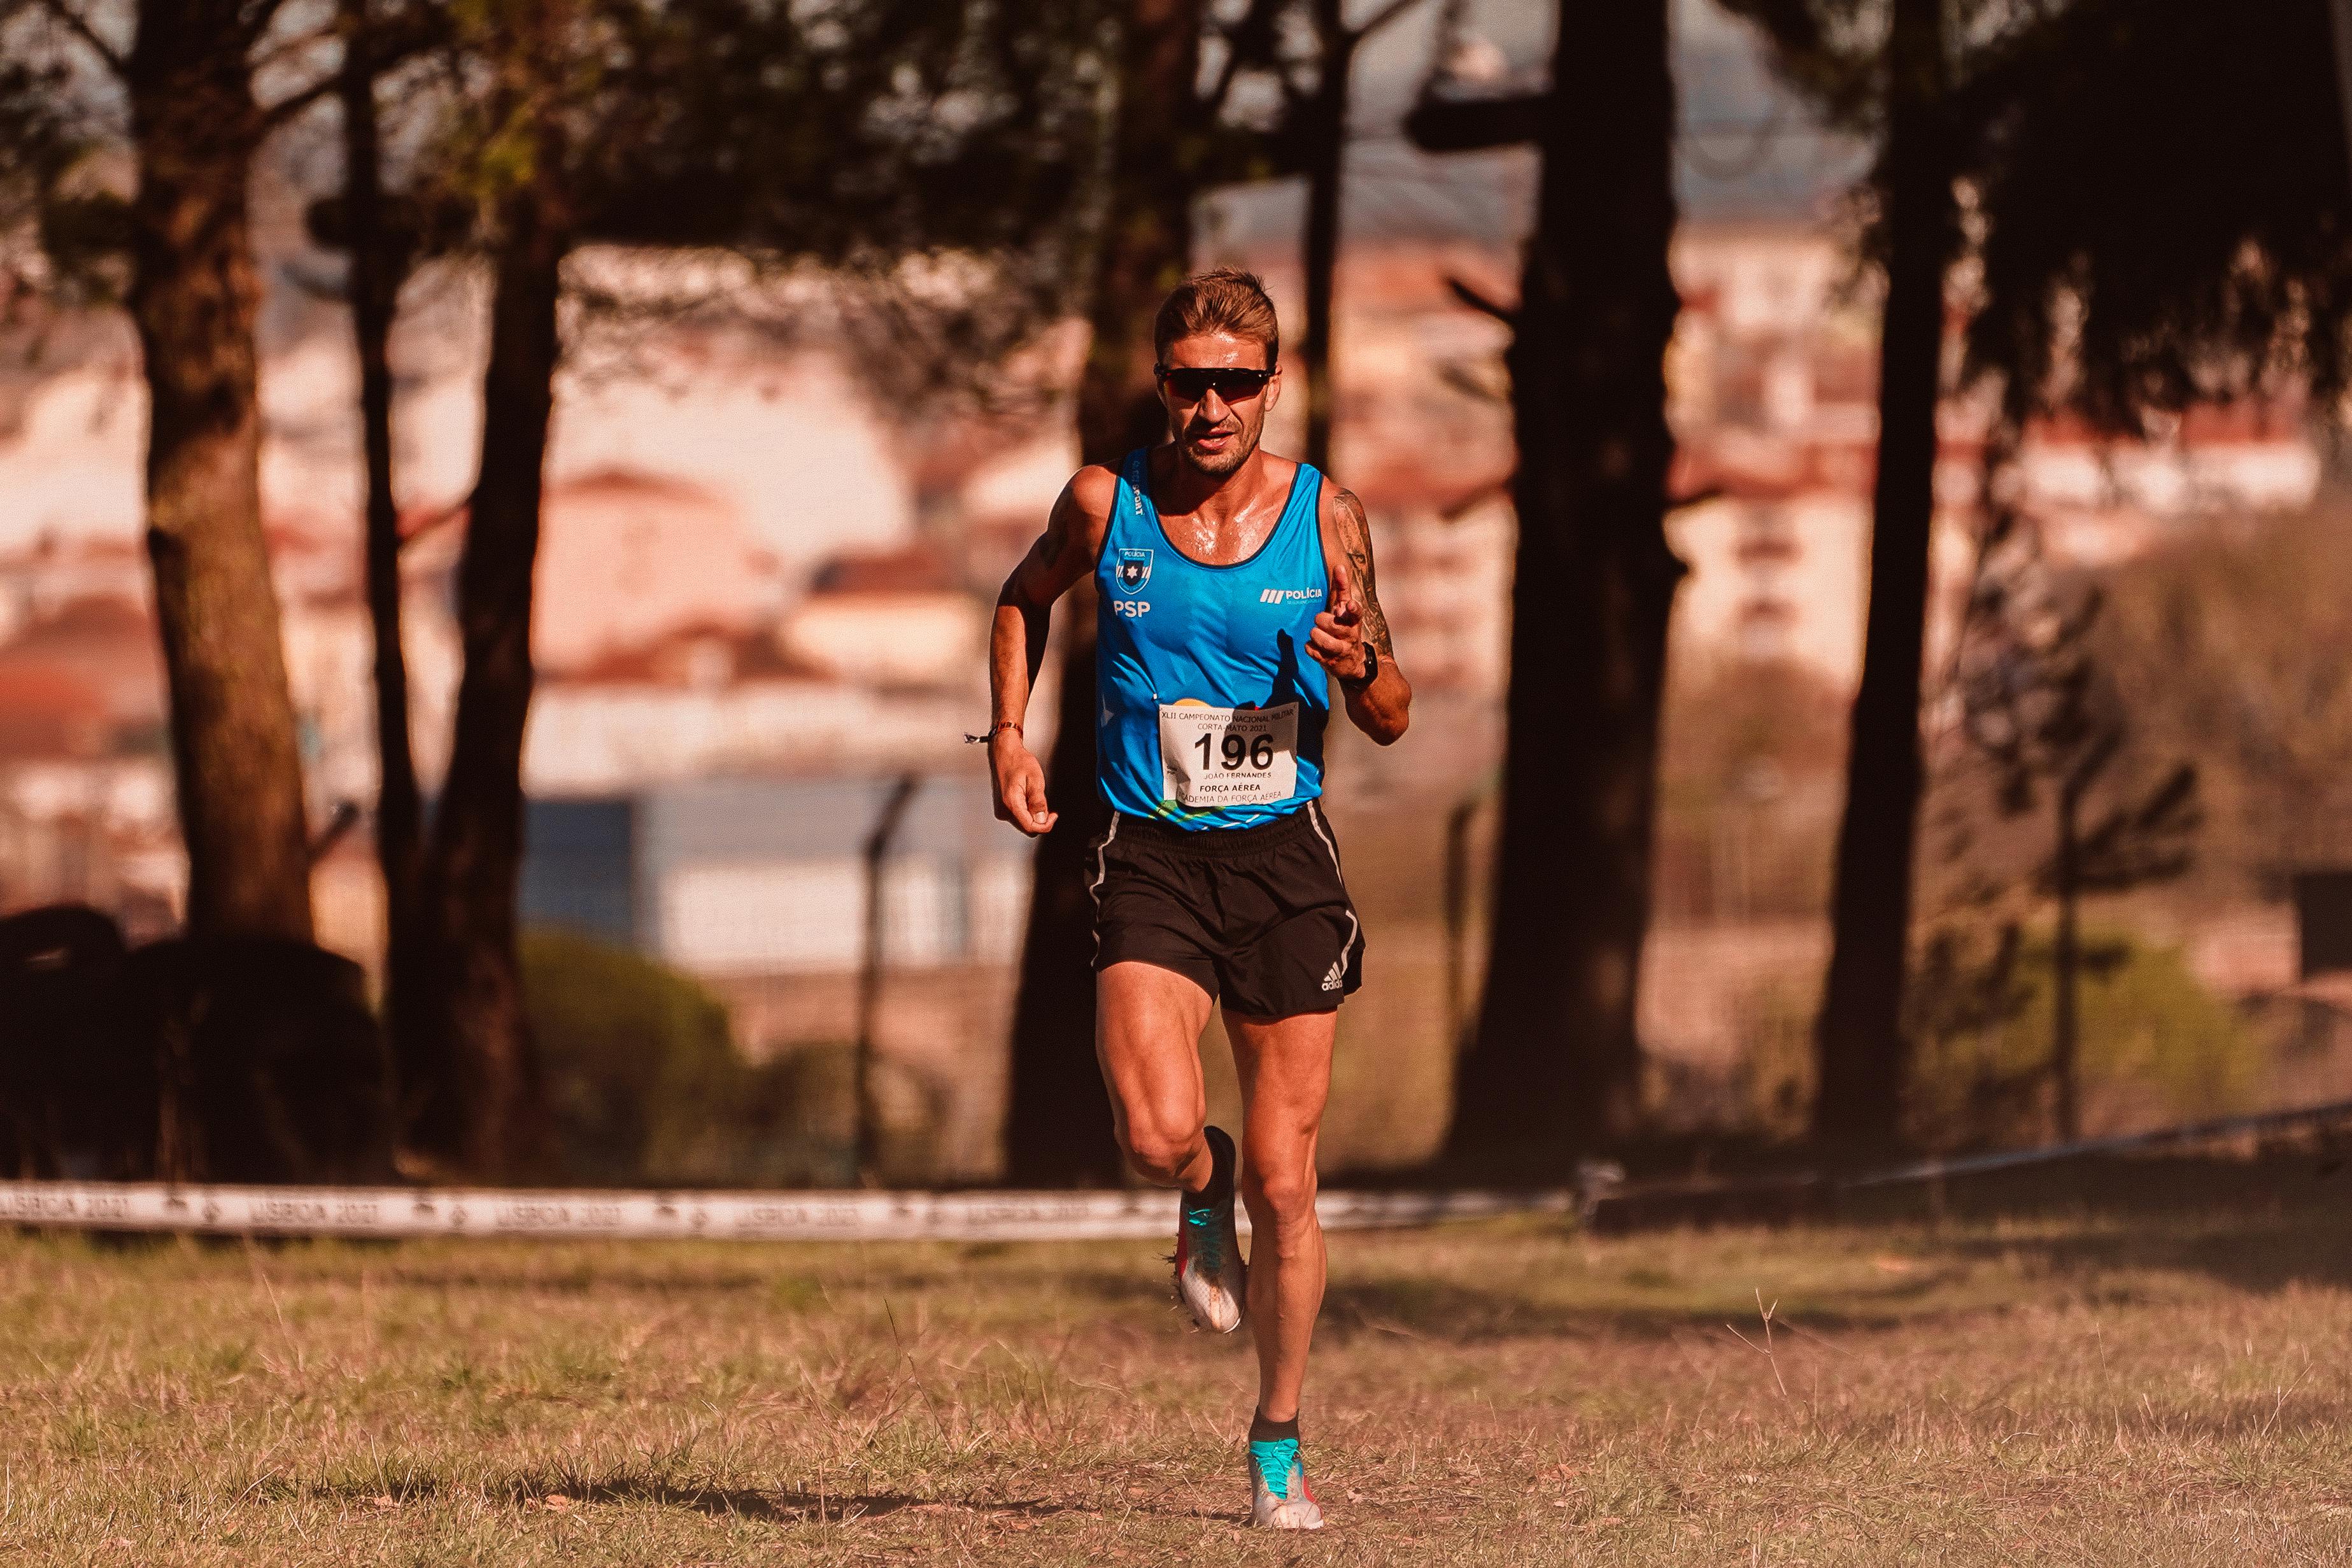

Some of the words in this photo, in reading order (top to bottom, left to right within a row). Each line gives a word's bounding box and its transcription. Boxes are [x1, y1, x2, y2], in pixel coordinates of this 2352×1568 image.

[1133, 484, 1144, 515] SPORT
[1286, 587, 1322, 600] POLÍCIA
[1113, 600, 1151, 618] PSP
[1179, 712, 1231, 722] CAMPEONATO
[1198, 723, 1247, 732] CORTA-MATO
[1194, 733, 1273, 770] 196
[1200, 785, 1229, 793] FORÇA
[1232, 782, 1261, 791] AÉREA
